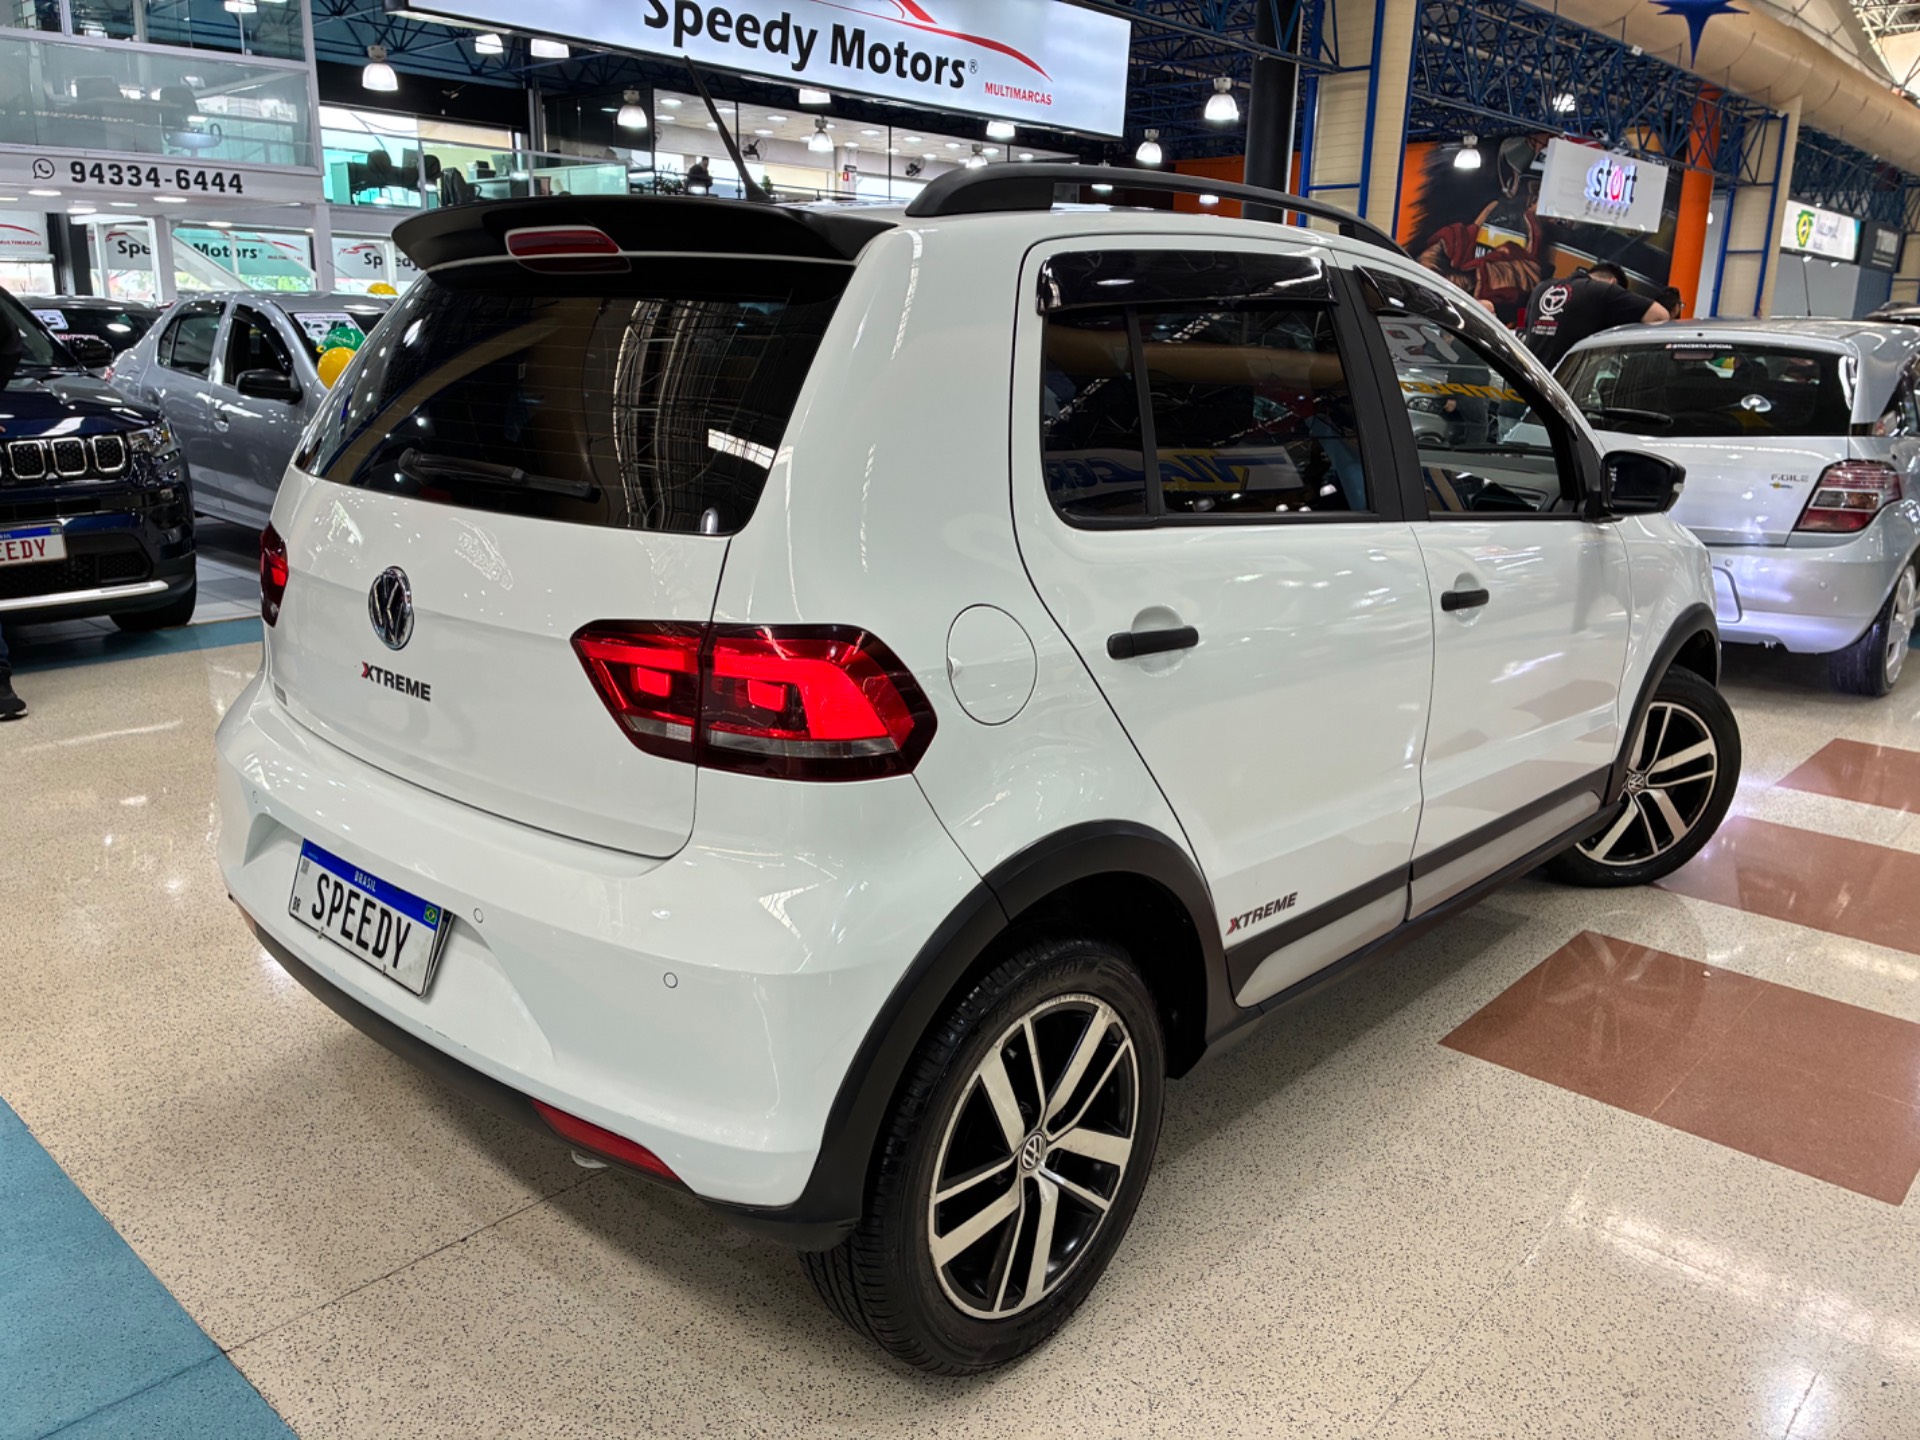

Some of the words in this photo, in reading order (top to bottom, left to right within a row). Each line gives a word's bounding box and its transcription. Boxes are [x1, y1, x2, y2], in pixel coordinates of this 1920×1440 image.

[643, 0, 818, 71] Speedy
[984, 82, 1052, 105] MULTIMARCAS
[70, 161, 243, 194] 94334-6444
[363, 252, 418, 272] Sped
[361, 661, 431, 702] XTREME
[354, 870, 377, 893] BRASIL
[311, 872, 412, 969] SPEEDY
[1226, 891, 1298, 936] XTREME
